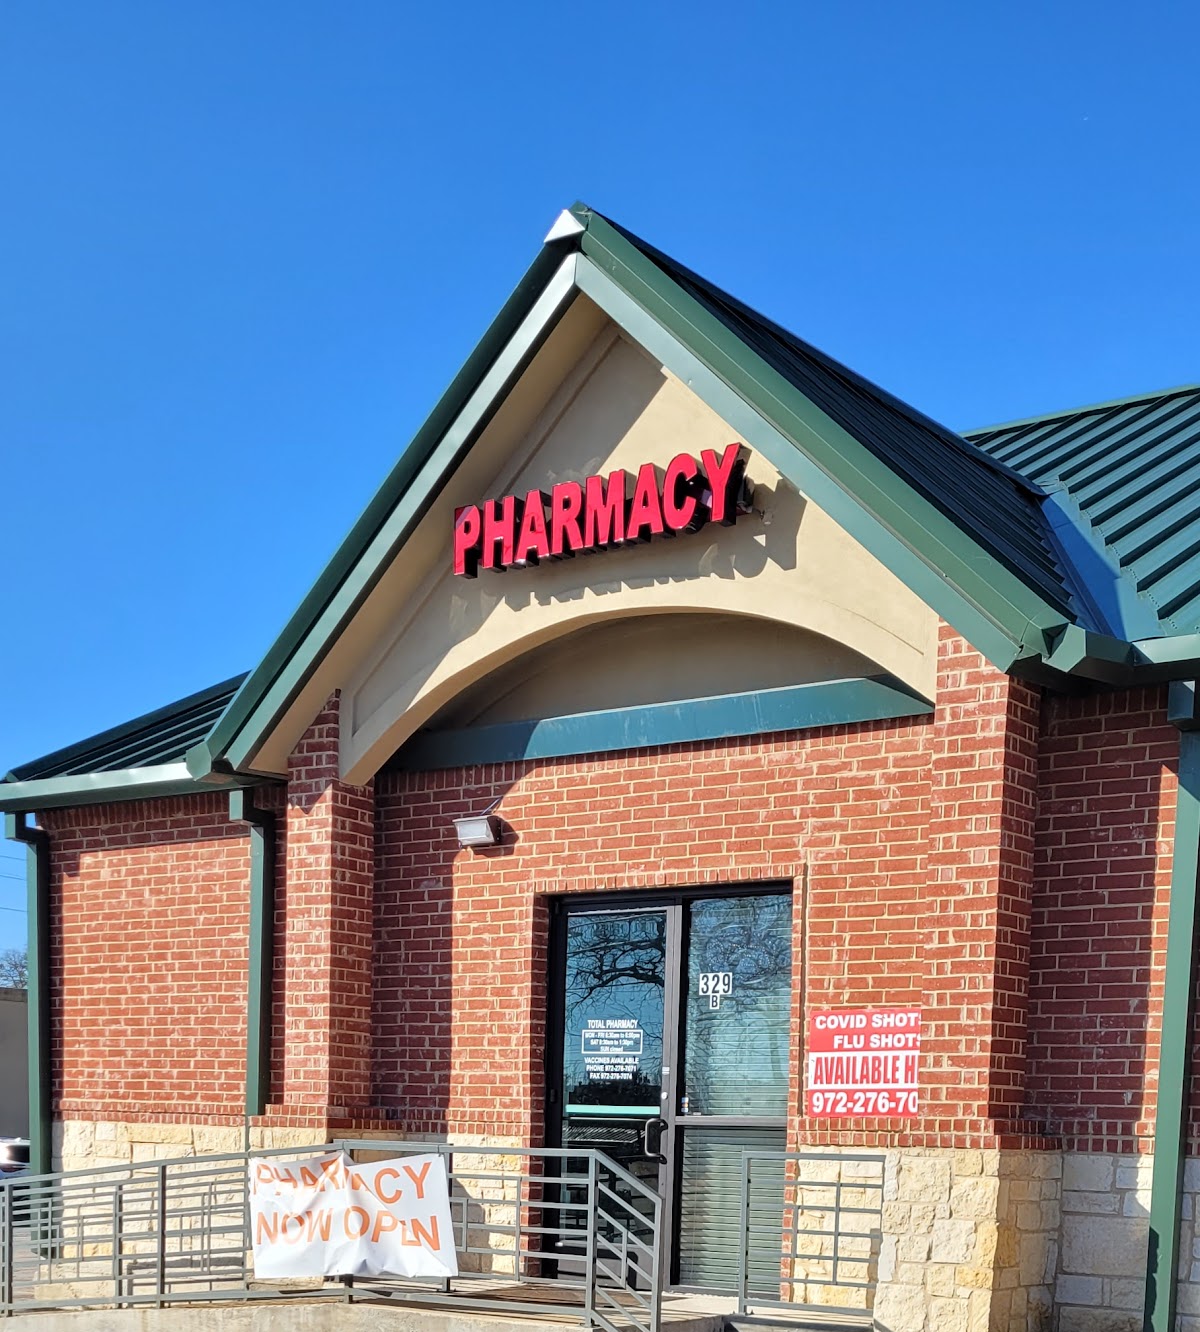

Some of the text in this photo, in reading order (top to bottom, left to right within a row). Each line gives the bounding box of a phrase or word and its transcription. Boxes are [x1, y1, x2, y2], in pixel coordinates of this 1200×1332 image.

[453, 442, 742, 576] PHARMACY
[701, 973, 731, 994] 329
[711, 995, 718, 1008] B
[587, 1019, 638, 1028] TOTAL PHARMACY
[815, 1012, 921, 1029] COVID SHOT
[833, 1035, 865, 1049] FLU
[813, 1055, 900, 1085] AVAILABLE
[812, 1091, 918, 1113] 972-276-70
[256, 1207, 334, 1245] NOW
